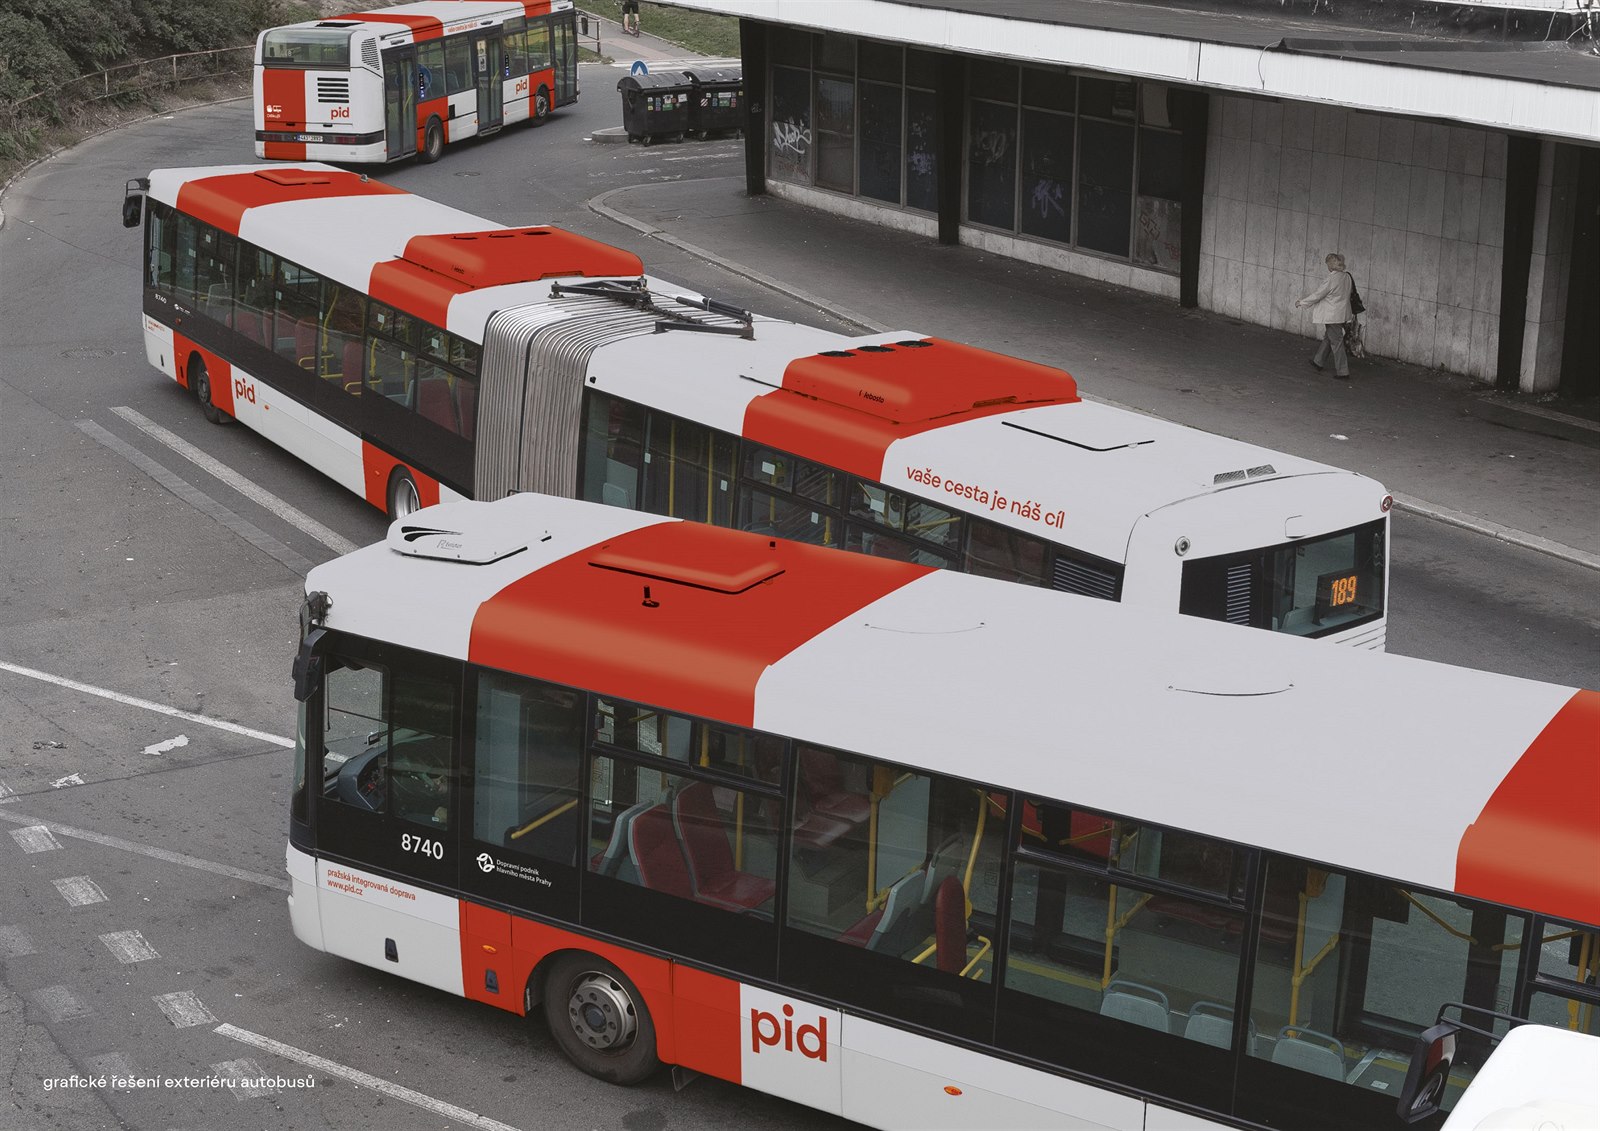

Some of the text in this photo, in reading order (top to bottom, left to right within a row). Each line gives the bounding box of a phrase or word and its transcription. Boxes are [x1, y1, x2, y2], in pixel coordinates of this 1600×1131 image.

[516, 79, 527, 95] pid
[331, 107, 350, 120] pid
[235, 378, 256, 405] pid
[906, 467, 1065, 529] vaše cesta je náš cíl
[1332, 575, 1357, 607] 189
[401, 833, 444, 860] 8740
[496, 859, 539, 876] Dopravní podnik
[496, 867, 519, 878] hlavního
[536, 876, 552, 888] Prahy
[327, 869, 416, 901] pražská integrovaná doprava
[327, 879, 363, 896] www.pid.cz
[750, 1003, 828, 1063] pid
